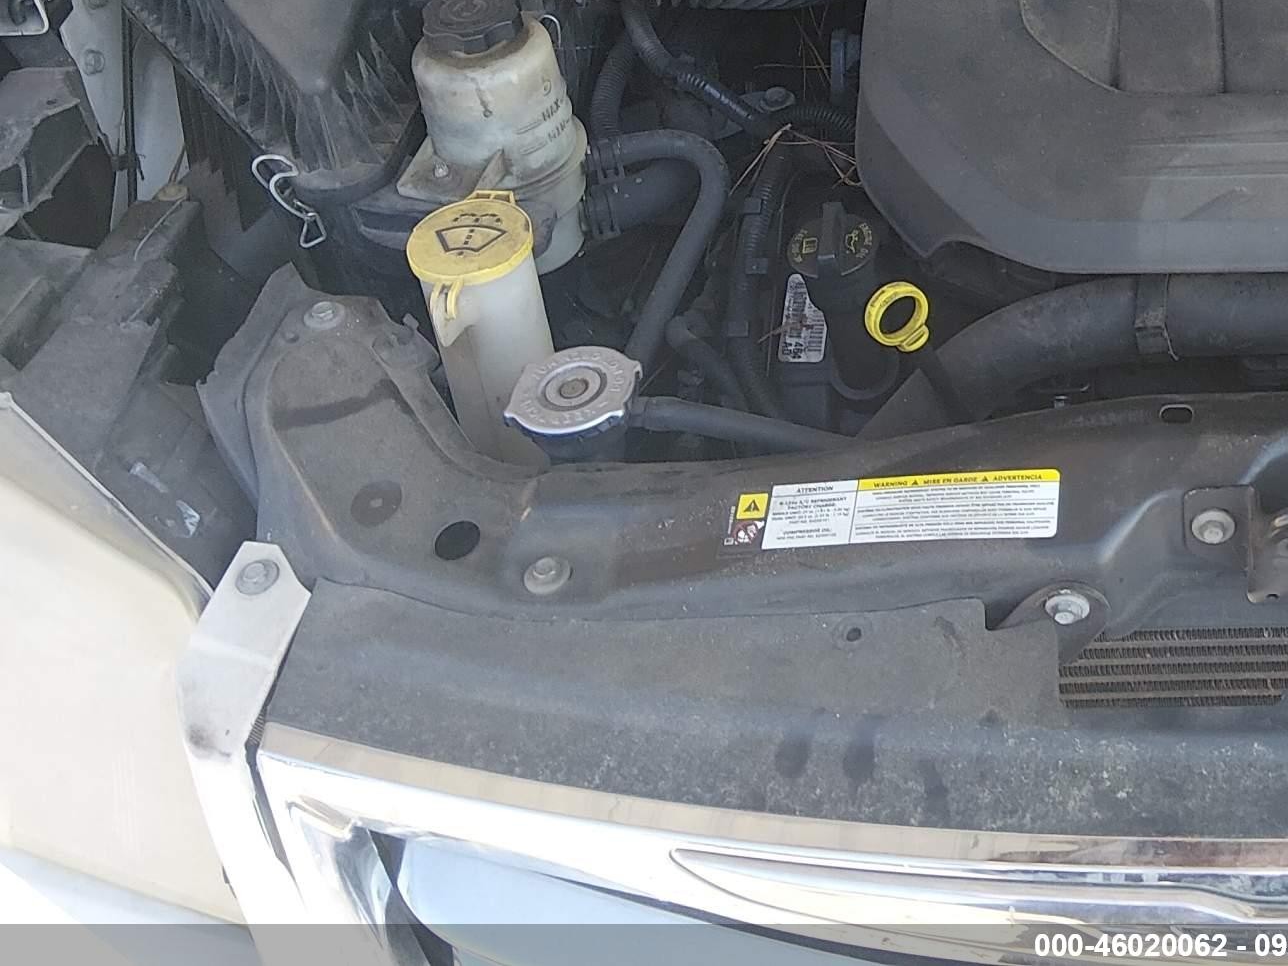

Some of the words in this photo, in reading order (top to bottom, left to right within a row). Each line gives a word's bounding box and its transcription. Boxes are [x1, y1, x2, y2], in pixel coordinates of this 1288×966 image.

[873, 480, 908, 488] WARNING
[953, 476, 977, 484] GARDE
[993, 474, 1042, 482] ADVERTENCIA
[796, 485, 834, 493] ATTENTION
